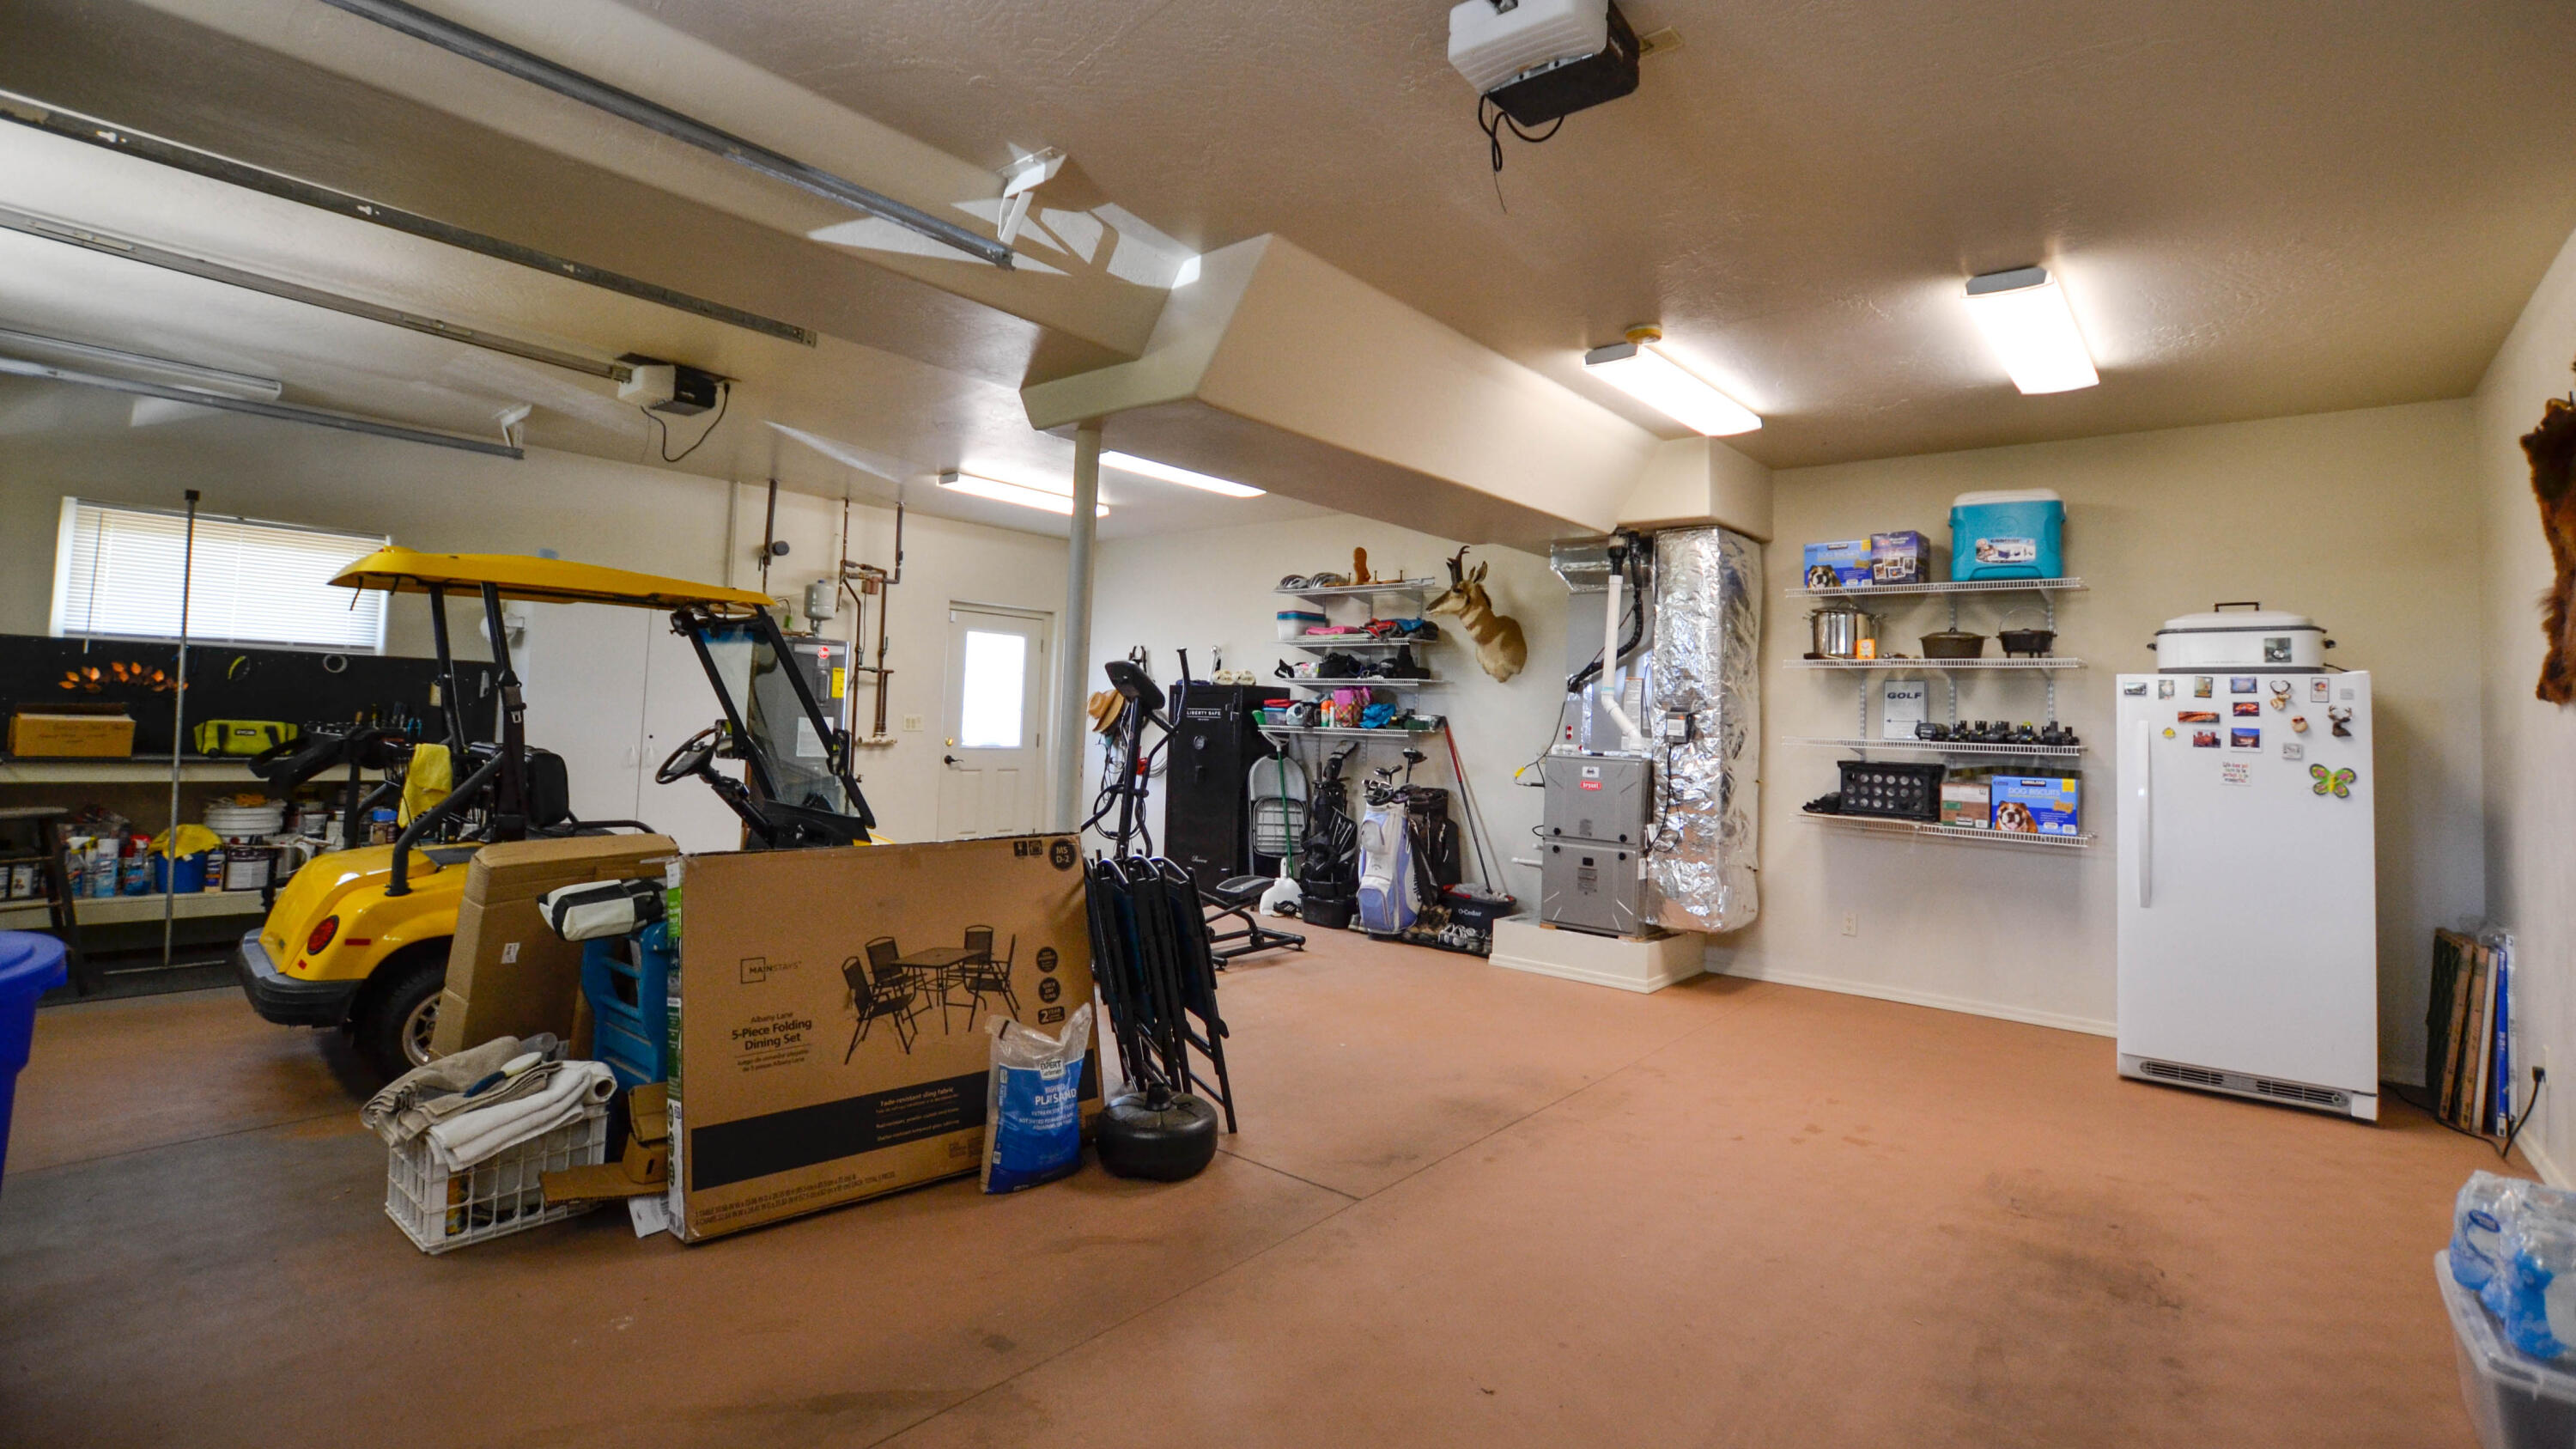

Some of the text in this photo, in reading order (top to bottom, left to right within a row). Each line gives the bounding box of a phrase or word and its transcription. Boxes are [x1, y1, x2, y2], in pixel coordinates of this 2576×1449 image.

[1056, 846, 1068, 855] MS
[1056, 855, 1070, 863] D-2
[732, 1020, 812, 1040] 5-Piece Folding
[744, 1032, 801, 1050] Dining Set
[1041, 1060, 1061, 1070] EXPERT
[1035, 1088, 1078, 1105] PLAY SAND
